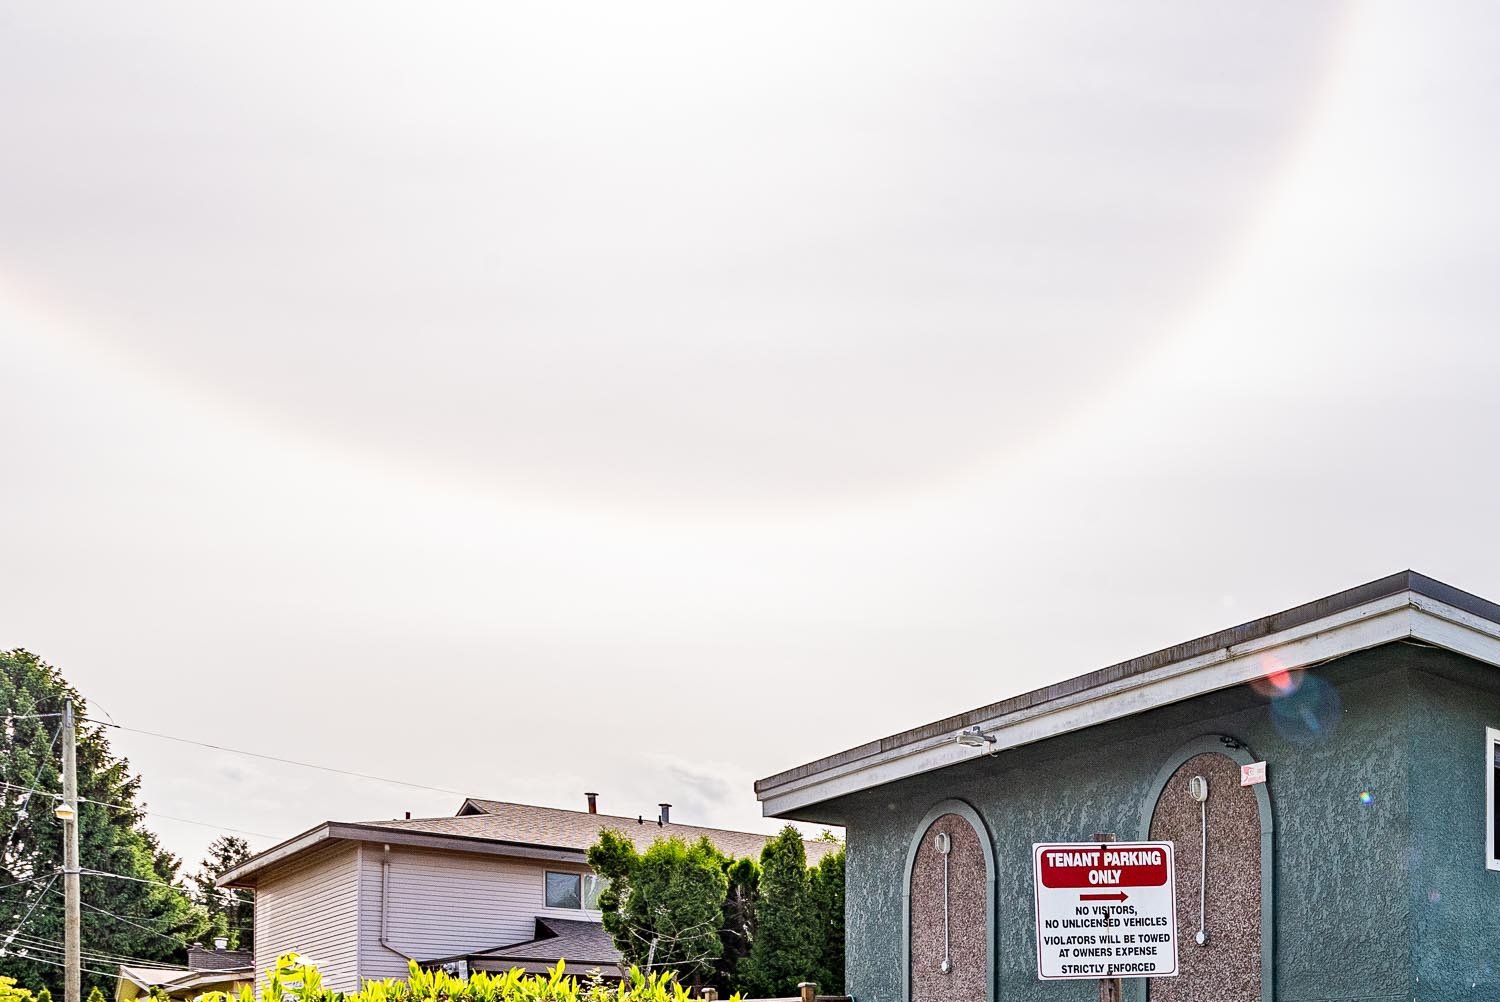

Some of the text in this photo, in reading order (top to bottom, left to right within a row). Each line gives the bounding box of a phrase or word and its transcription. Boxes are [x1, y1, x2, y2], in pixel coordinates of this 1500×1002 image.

[1046, 851, 1161, 867] TENANT PARKING
[1088, 869, 1121, 884] ONLY
[1075, 905, 1138, 916] NO VISITORS,
[1045, 917, 1167, 929] NO UNLICENSED VEHICLES
[1044, 933, 1170, 945] VIOLATORS WILL BE TOWED
[1058, 946, 1157, 958] AT OWNERS EXPENSE
[1061, 962, 1156, 974] STRICTLY ENFORCED
